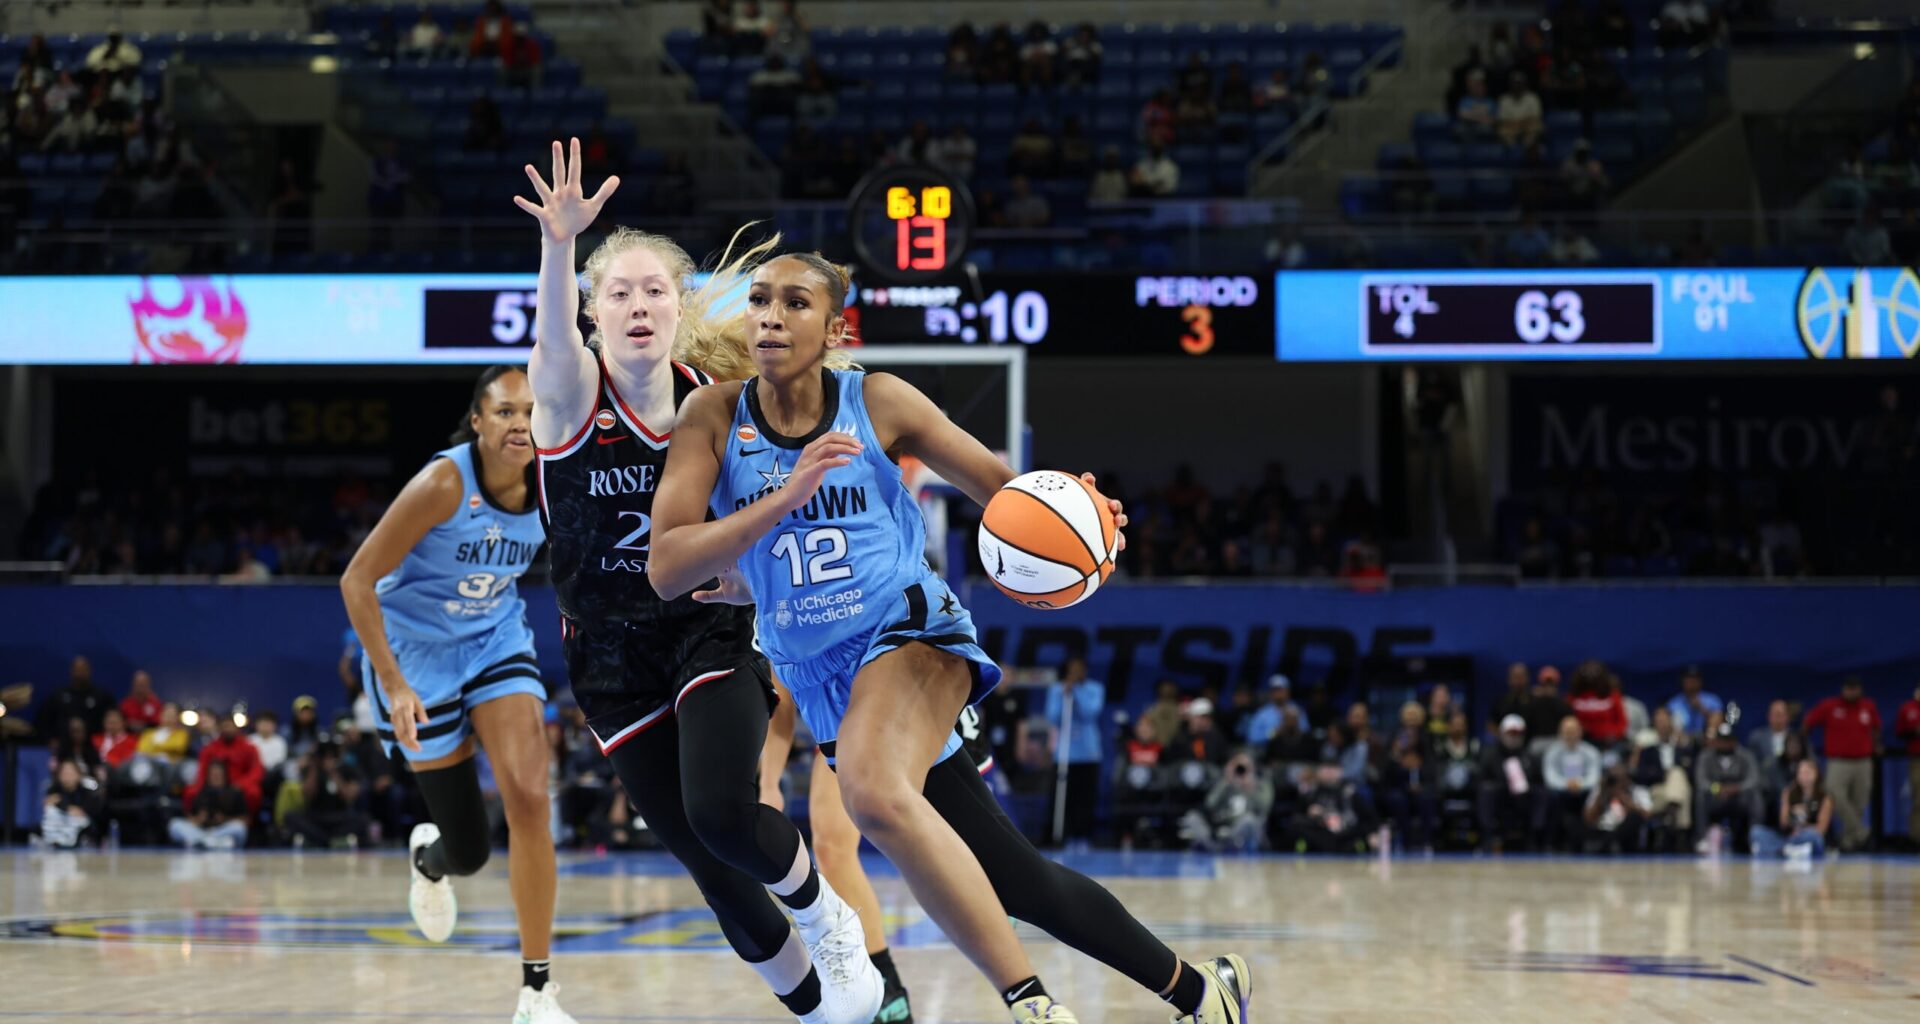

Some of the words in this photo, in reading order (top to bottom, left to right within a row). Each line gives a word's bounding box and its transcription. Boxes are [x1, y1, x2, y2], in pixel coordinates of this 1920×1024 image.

[887, 186, 951, 219] 6:10
[897, 216, 945, 270] 13
[1136, 276, 1258, 306] PERIOD
[1376, 286, 1435, 314] TOL
[1671, 275, 1752, 303] FOUL
[1180, 305, 1215, 355] 3
[1514, 290, 1583, 343] 63
[1694, 305, 1726, 332] 01
[188, 395, 389, 445] bet365
[587, 465, 655, 498] ROSE
[769, 526, 854, 588] 12
[793, 589, 863, 611] UChicago
[796, 603, 865, 627] Medicine
